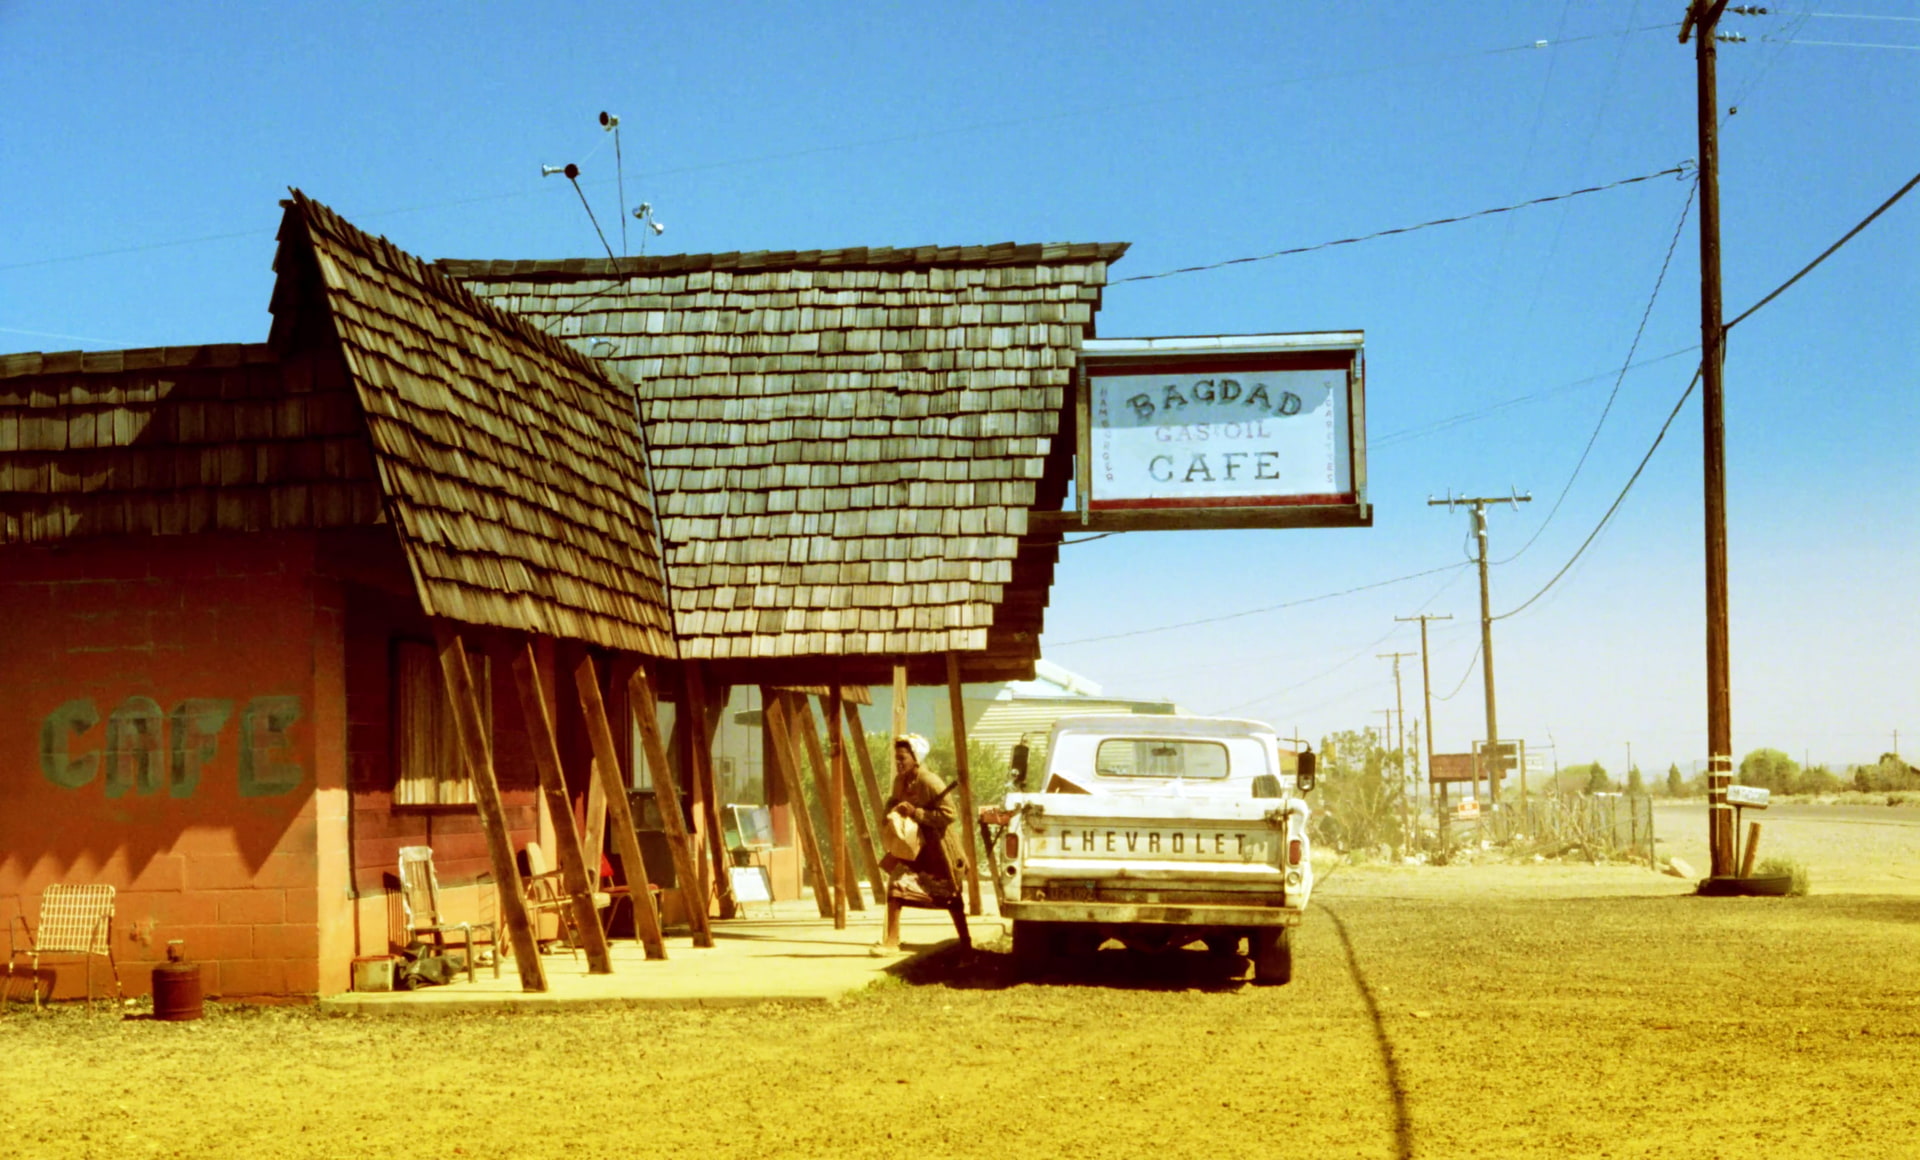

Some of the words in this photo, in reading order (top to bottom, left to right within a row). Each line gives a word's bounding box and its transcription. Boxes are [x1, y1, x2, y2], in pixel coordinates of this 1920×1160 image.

[1126, 379, 1303, 419] BAGDAD
[1155, 422, 1210, 442] GAS
[1223, 419, 1272, 440] OIL
[1149, 451, 1280, 483] CAFE
[39, 695, 304, 798] CAFE
[1061, 829, 1247, 855] CHEVROLET
